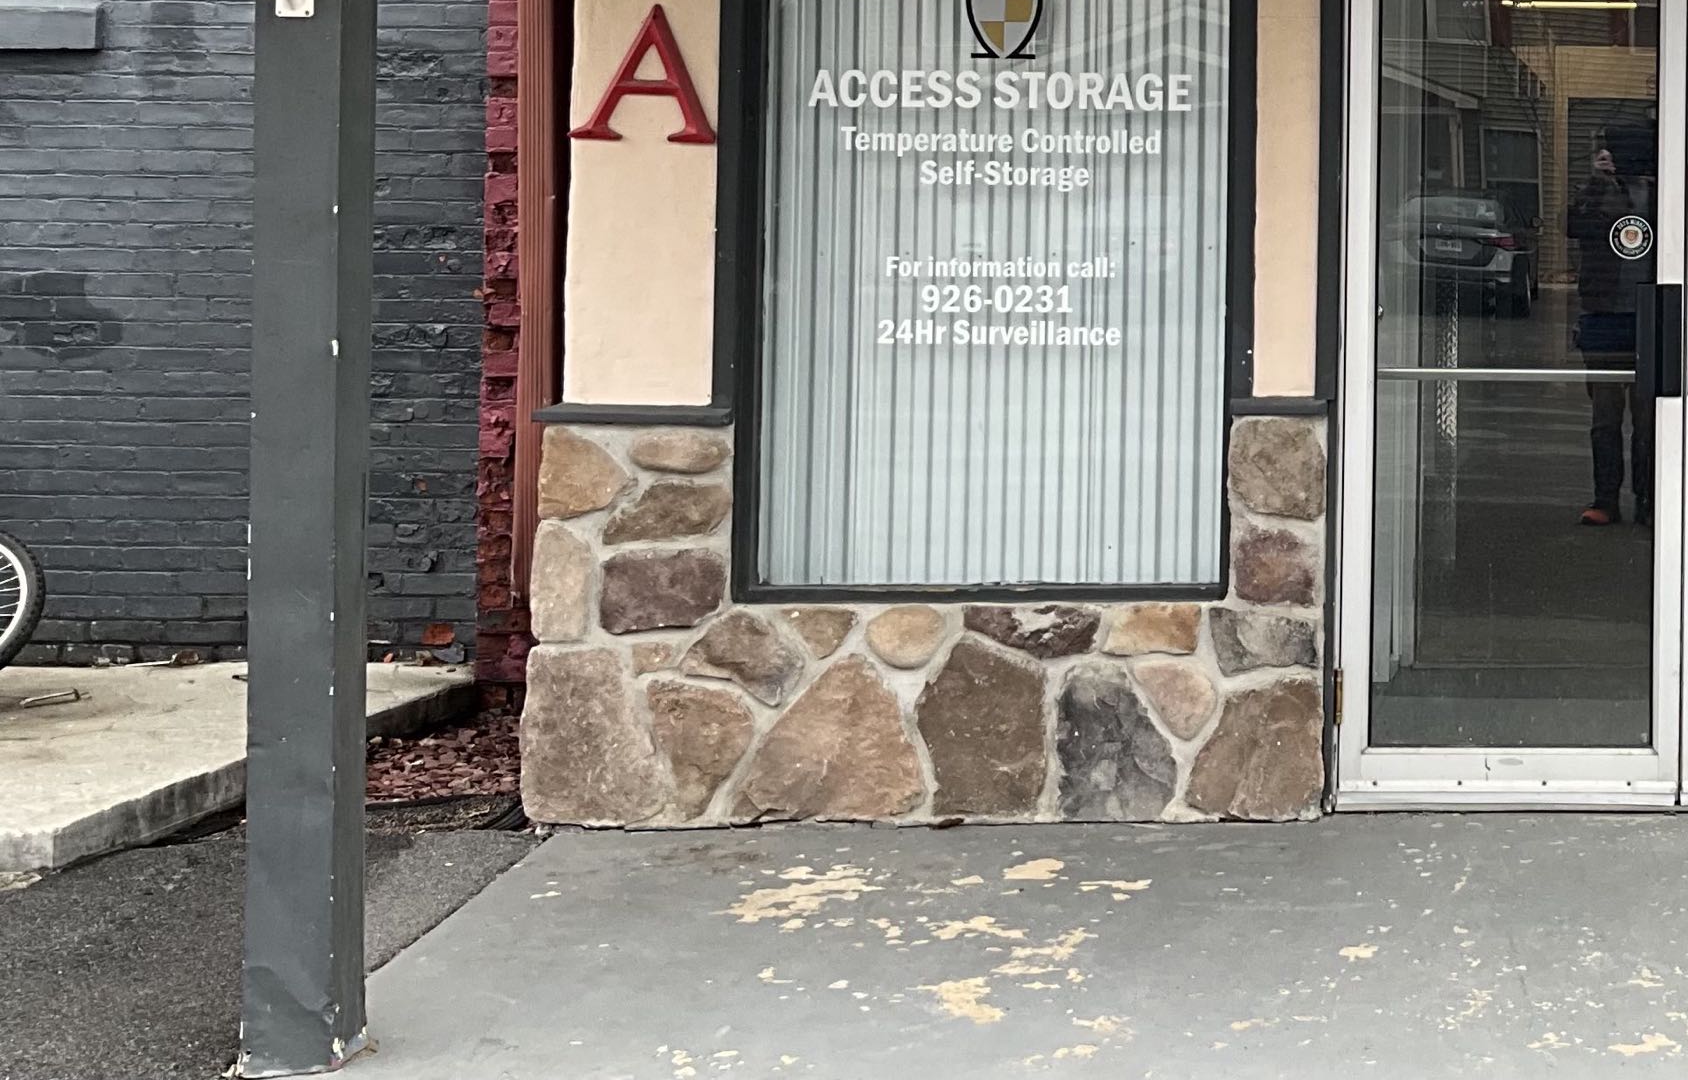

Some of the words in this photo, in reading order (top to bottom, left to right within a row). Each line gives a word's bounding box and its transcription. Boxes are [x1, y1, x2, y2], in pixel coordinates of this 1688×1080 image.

[567, 3, 716, 144] A
[808, 69, 982, 108] ACCESS
[993, 71, 1192, 112] STORAGE
[840, 126, 1013, 157] Temperature
[1020, 128, 1161, 155] Controlled
[919, 160, 1090, 192] Self-Storage
[885, 257, 922, 278] For
[927, 256, 1061, 279] information
[1067, 256, 1116, 279] call:
[921, 285, 1073, 314] 926-0231
[877, 320, 946, 345] 24Hr
[953, 320, 1121, 347] Surveillance
